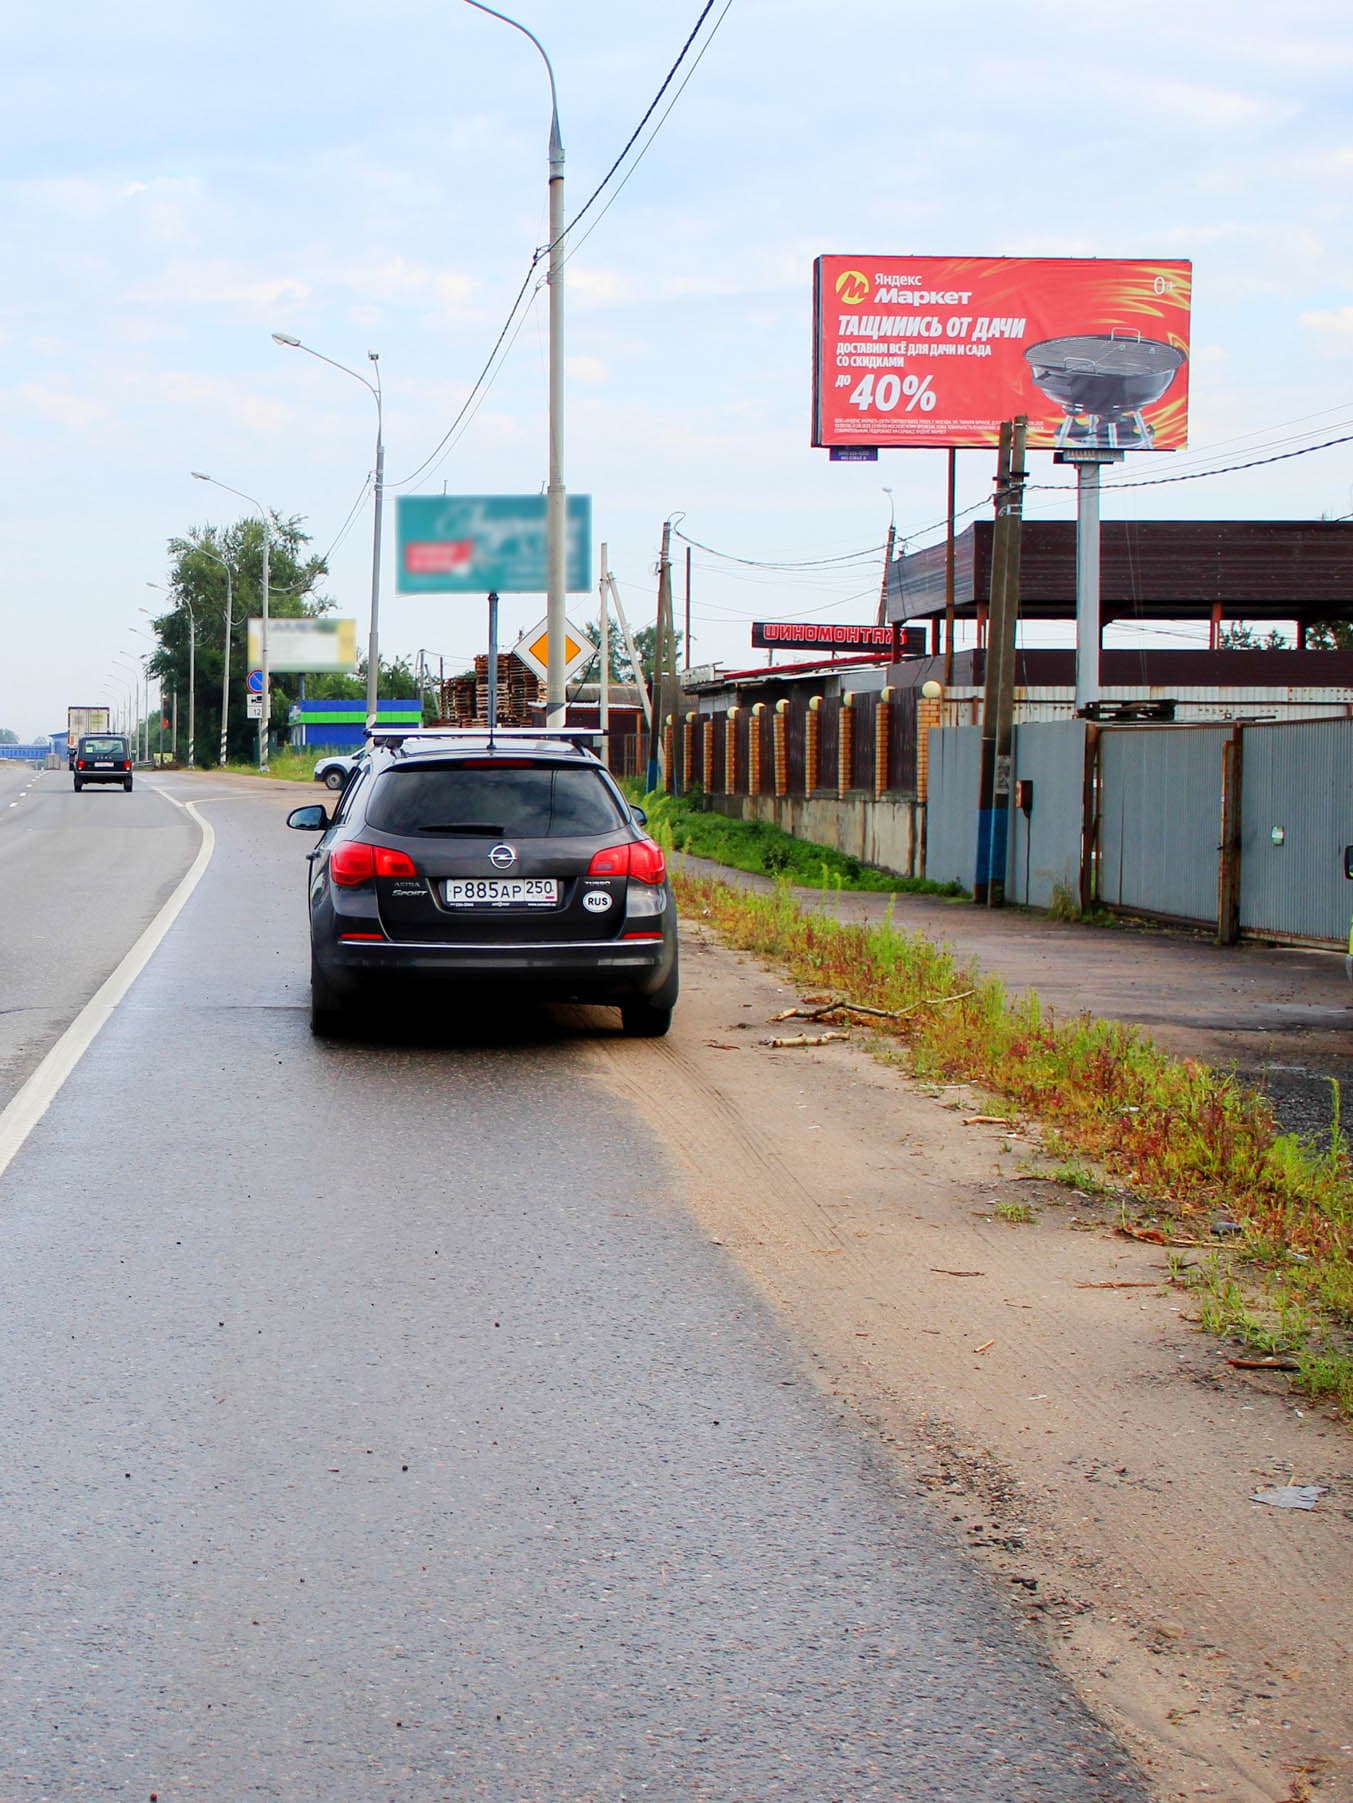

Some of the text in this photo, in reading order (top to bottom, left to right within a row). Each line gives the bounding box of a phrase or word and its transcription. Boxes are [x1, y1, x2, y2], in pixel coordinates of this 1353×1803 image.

[874, 273, 923, 286] Яндекс
[873, 288, 973, 307] Маркет
[837, 315, 1027, 342] ТАЩИИИСЬ ОТ ДАЧИ
[836, 341, 992, 357] ДОСТАВИМ ВСЁ ДЛЯ ДАЧИ И САДА
[836, 356, 905, 368] СО СКИДКАМИ
[849, 373, 936, 412] 40%
[525, 880, 553, 894] 250
[588, 897, 609, 906] RUS
